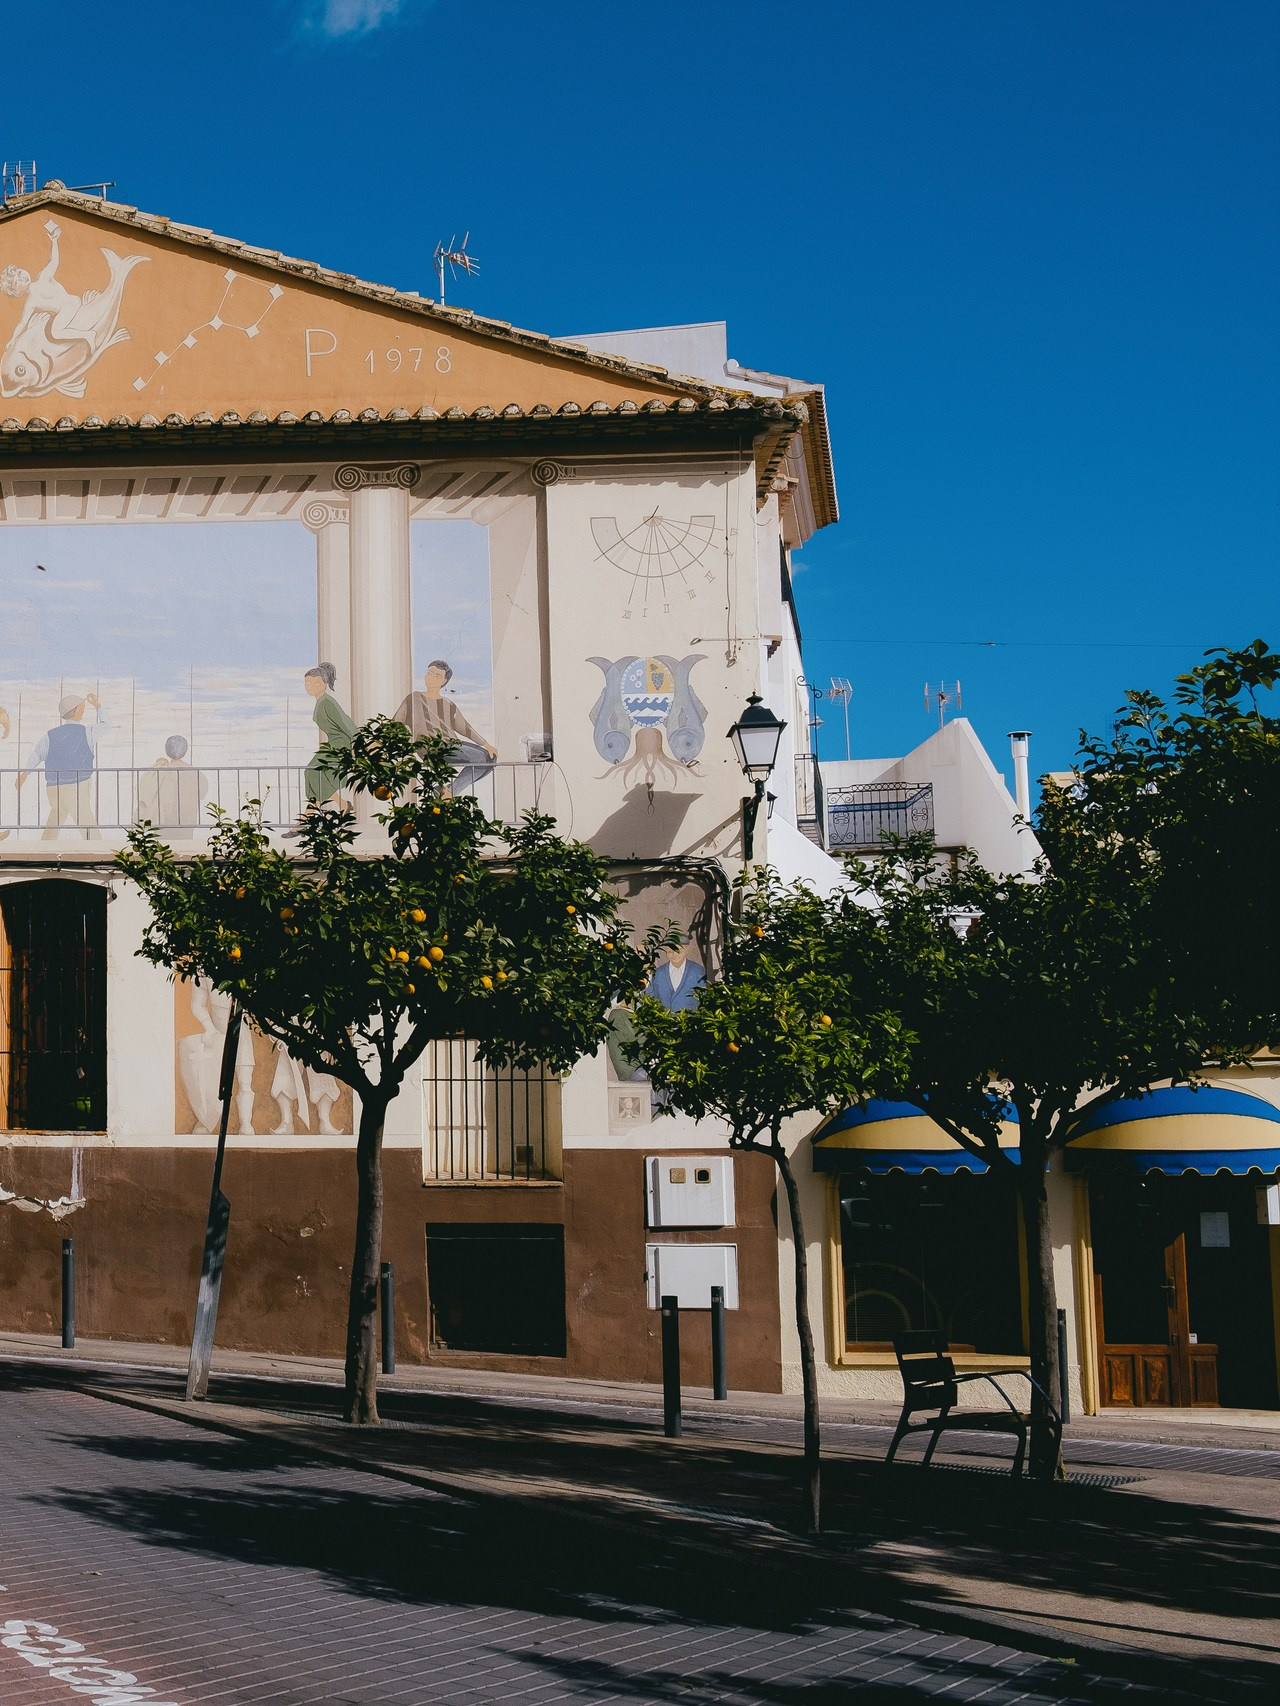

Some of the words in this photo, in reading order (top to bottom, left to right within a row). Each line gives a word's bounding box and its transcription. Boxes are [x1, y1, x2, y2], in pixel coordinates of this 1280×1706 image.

[304, 328, 338, 377] P
[364, 346, 452, 374] 1978
[686, 588, 697, 600] III
[704, 570, 716, 584] IV
